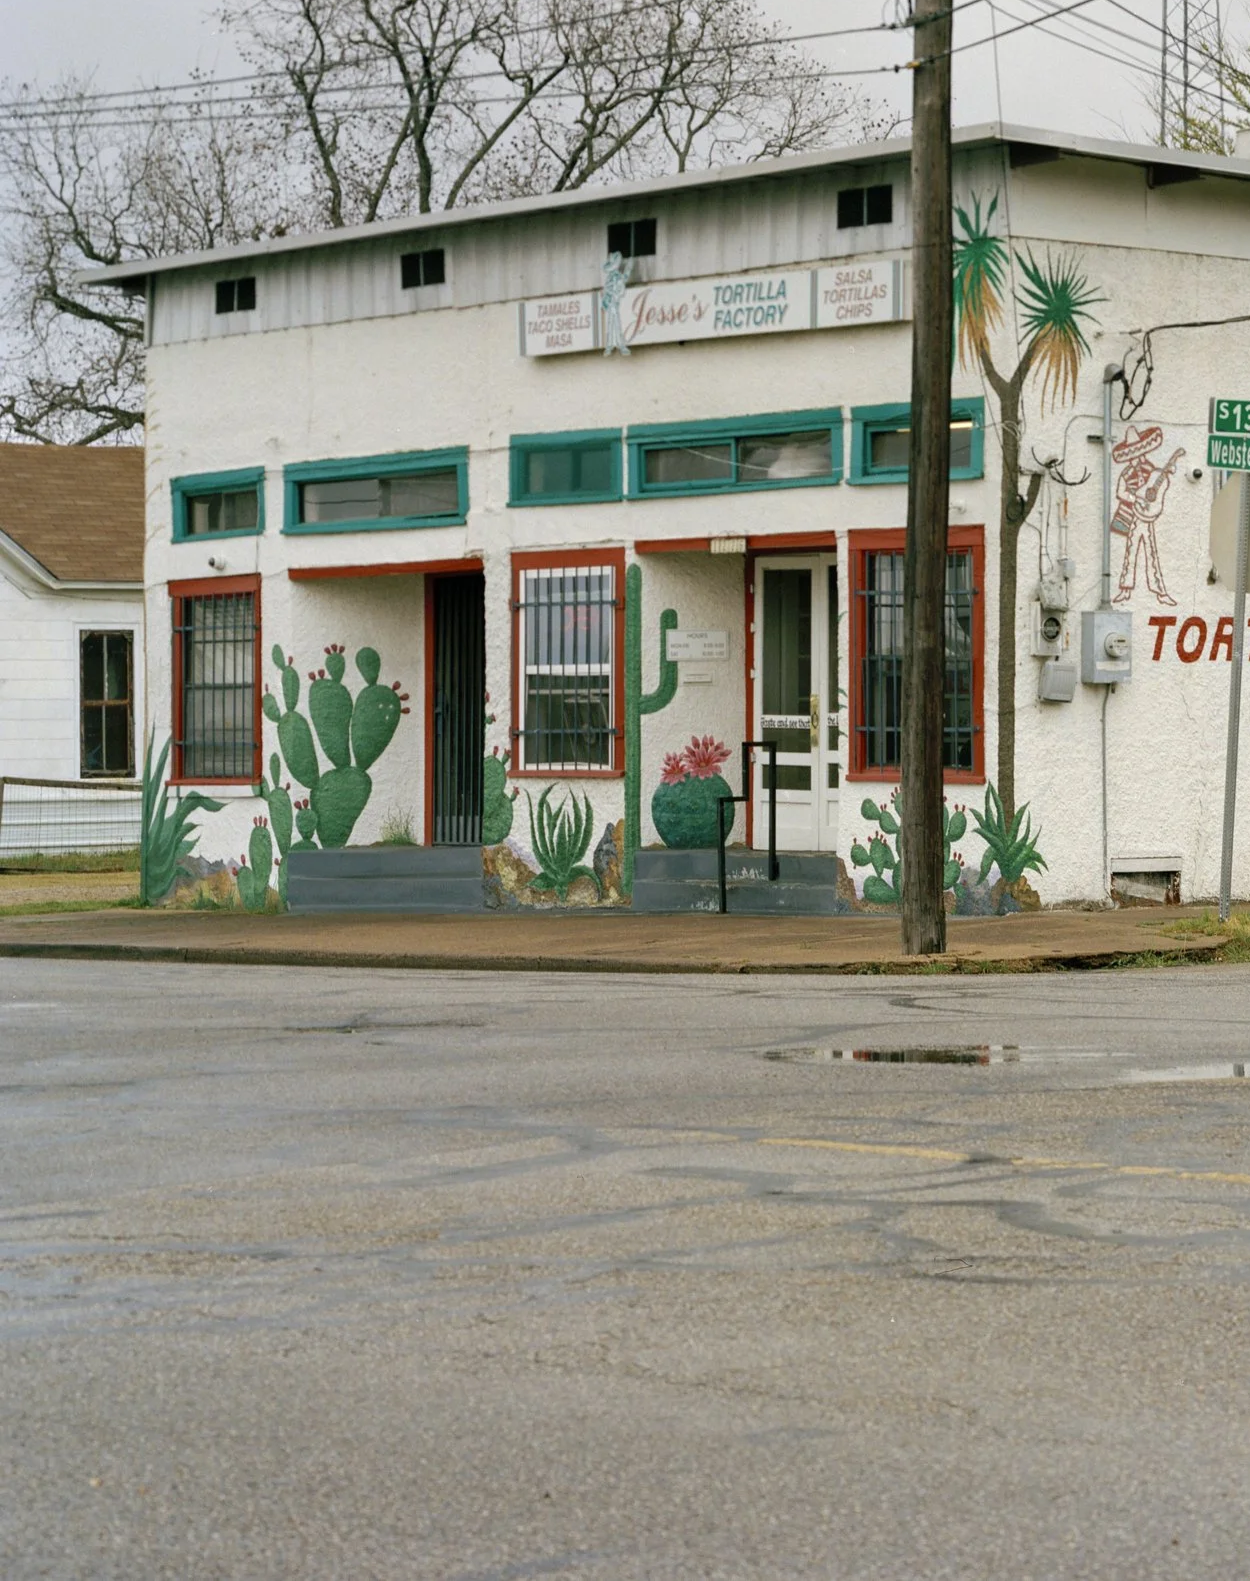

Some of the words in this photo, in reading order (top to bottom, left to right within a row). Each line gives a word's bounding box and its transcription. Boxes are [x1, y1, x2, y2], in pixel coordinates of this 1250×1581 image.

[834, 271, 873, 285] SALSA
[713, 279, 788, 302] TORTILLA
[823, 287, 887, 303] TORTILLAS
[537, 300, 581, 318] TAMALES
[625, 289, 709, 342] Jesse's
[713, 304, 789, 330] FACTORY
[836, 302, 873, 319] CHIPS
[527, 321, 553, 334] TACO
[554, 315, 591, 331] SHELLS
[545, 333, 573, 348] MASA
[1219, 402, 1229, 419] S
